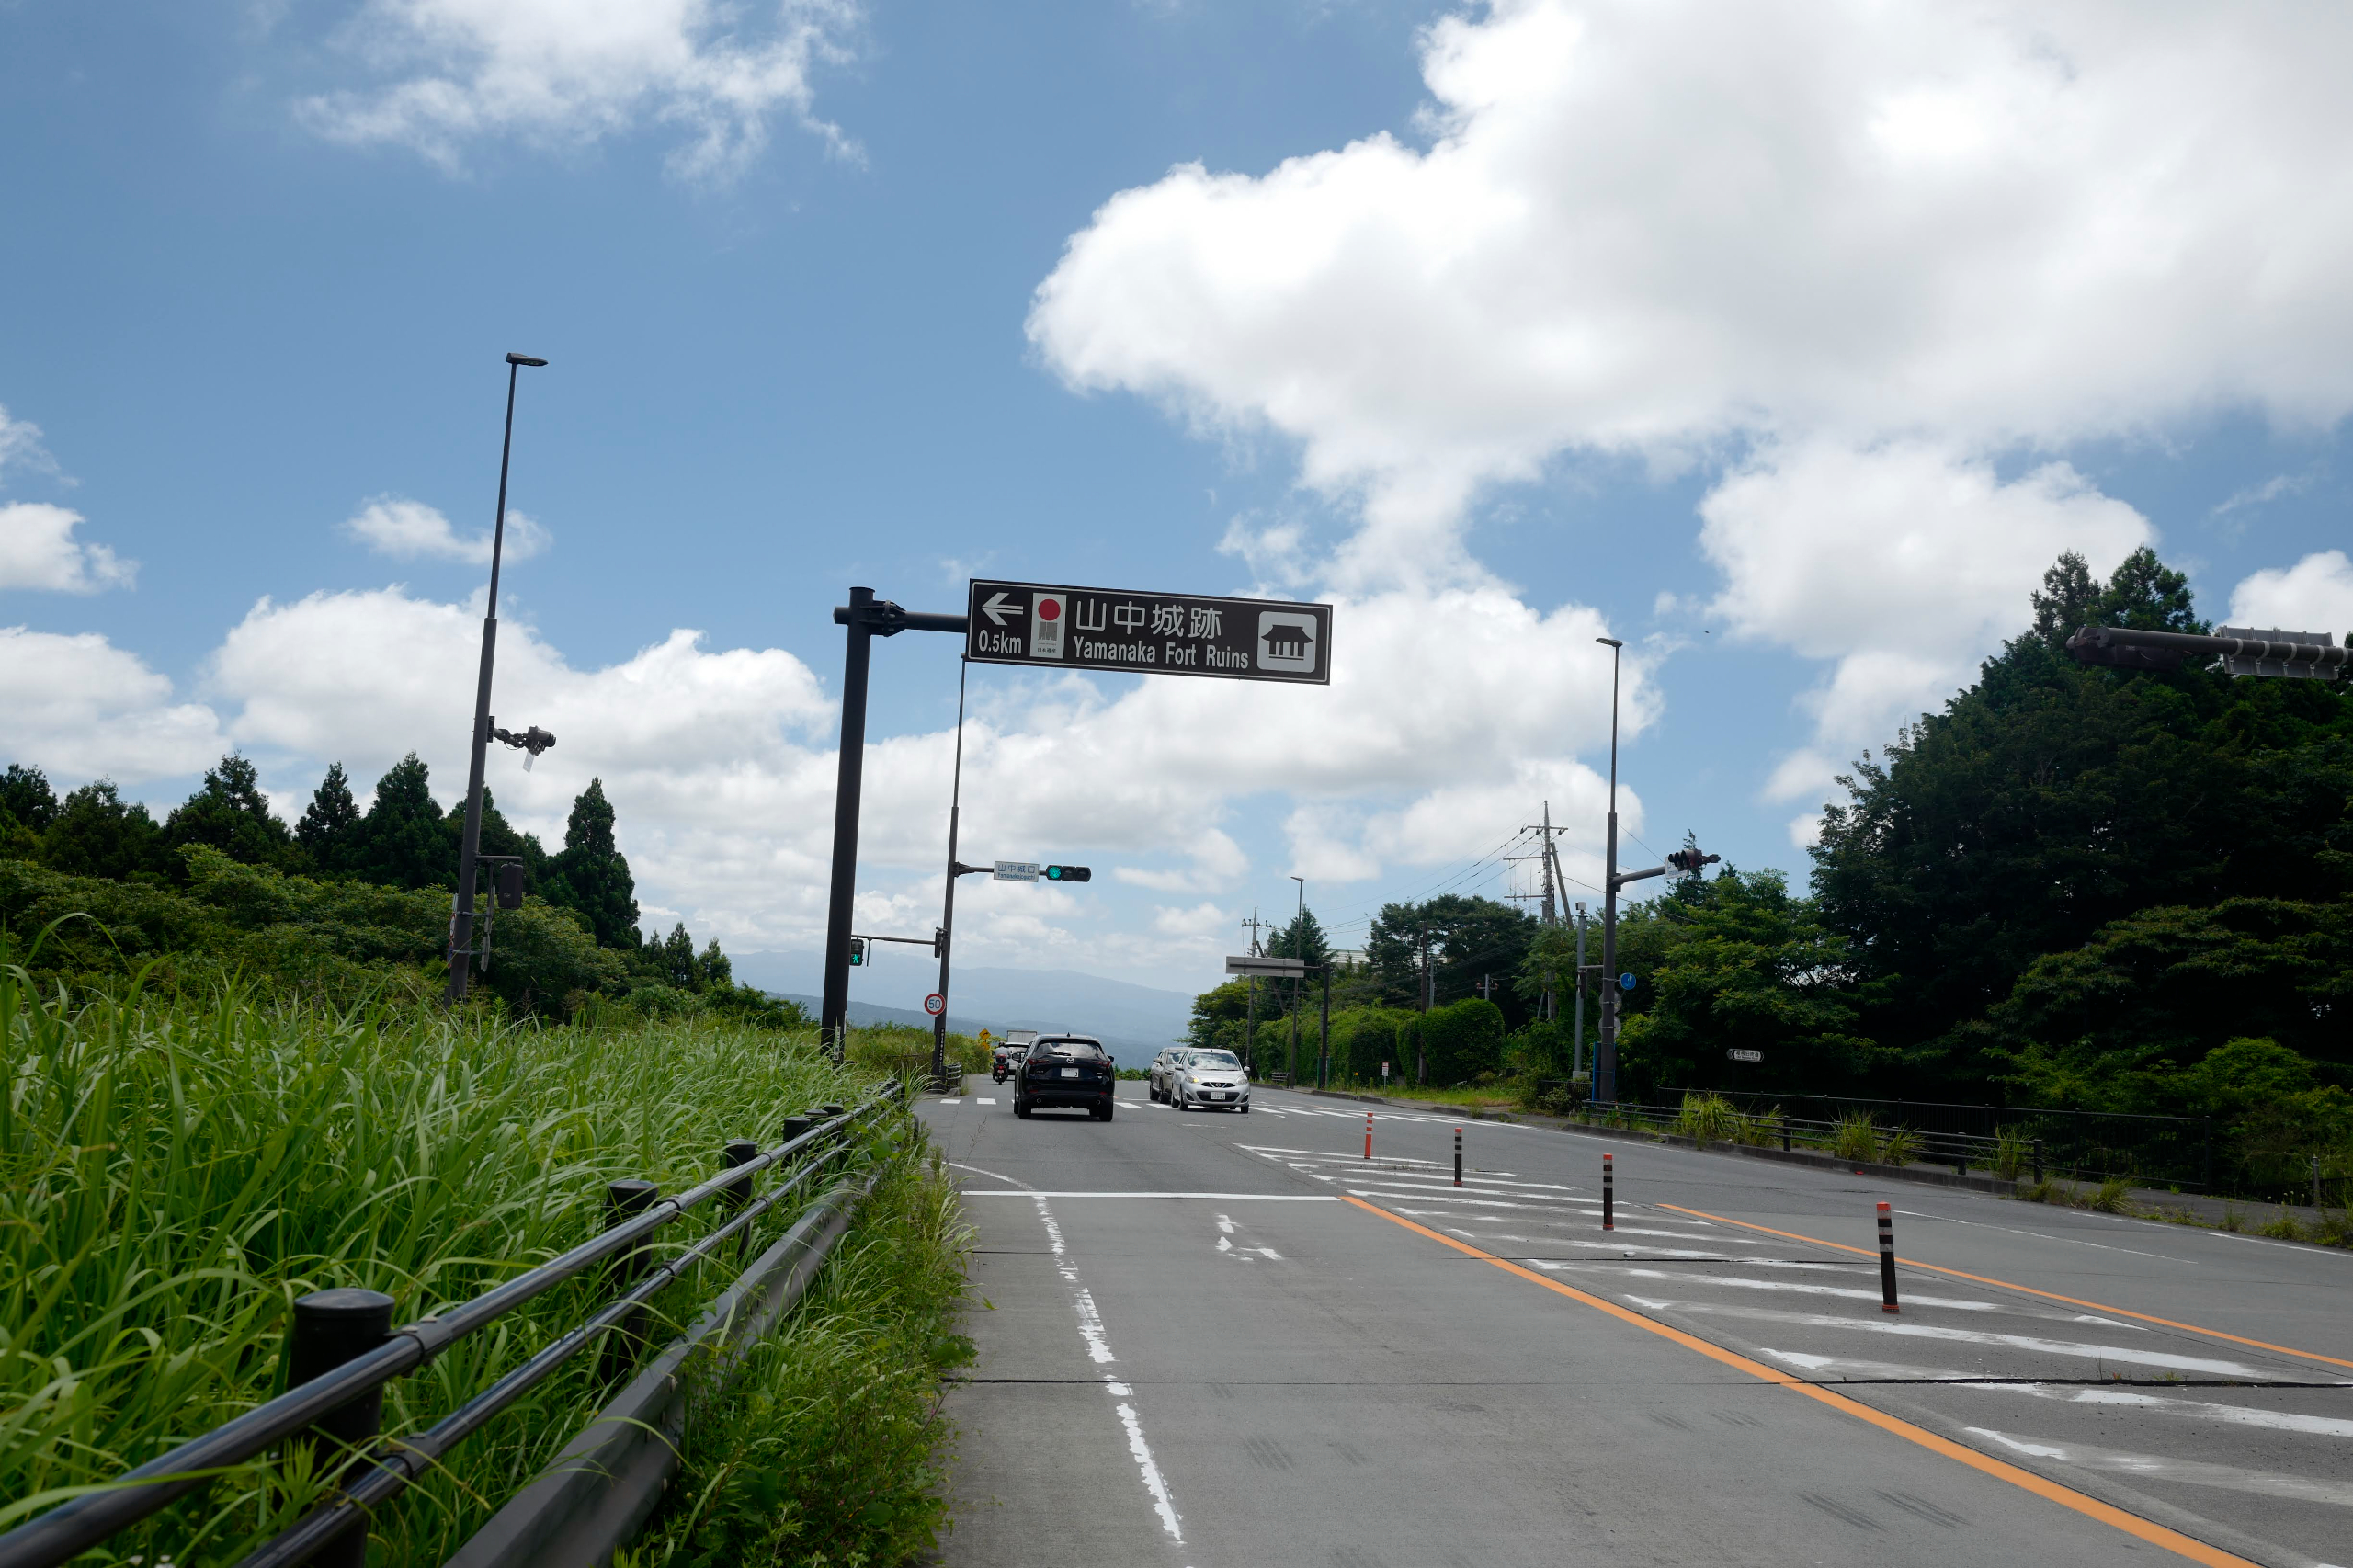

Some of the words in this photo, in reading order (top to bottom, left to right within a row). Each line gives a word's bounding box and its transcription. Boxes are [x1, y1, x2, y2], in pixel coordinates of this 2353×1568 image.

[1075, 598, 1223, 640] 山中城跡
[978, 629, 1022, 655] 0.5km
[1074, 635, 1156, 664] Yamanaka
[1165, 642, 1198, 666] Fort
[1205, 645, 1249, 670] Ruins
[997, 864, 1036, 874] 山中城口
[928, 999, 941, 1009] 50
